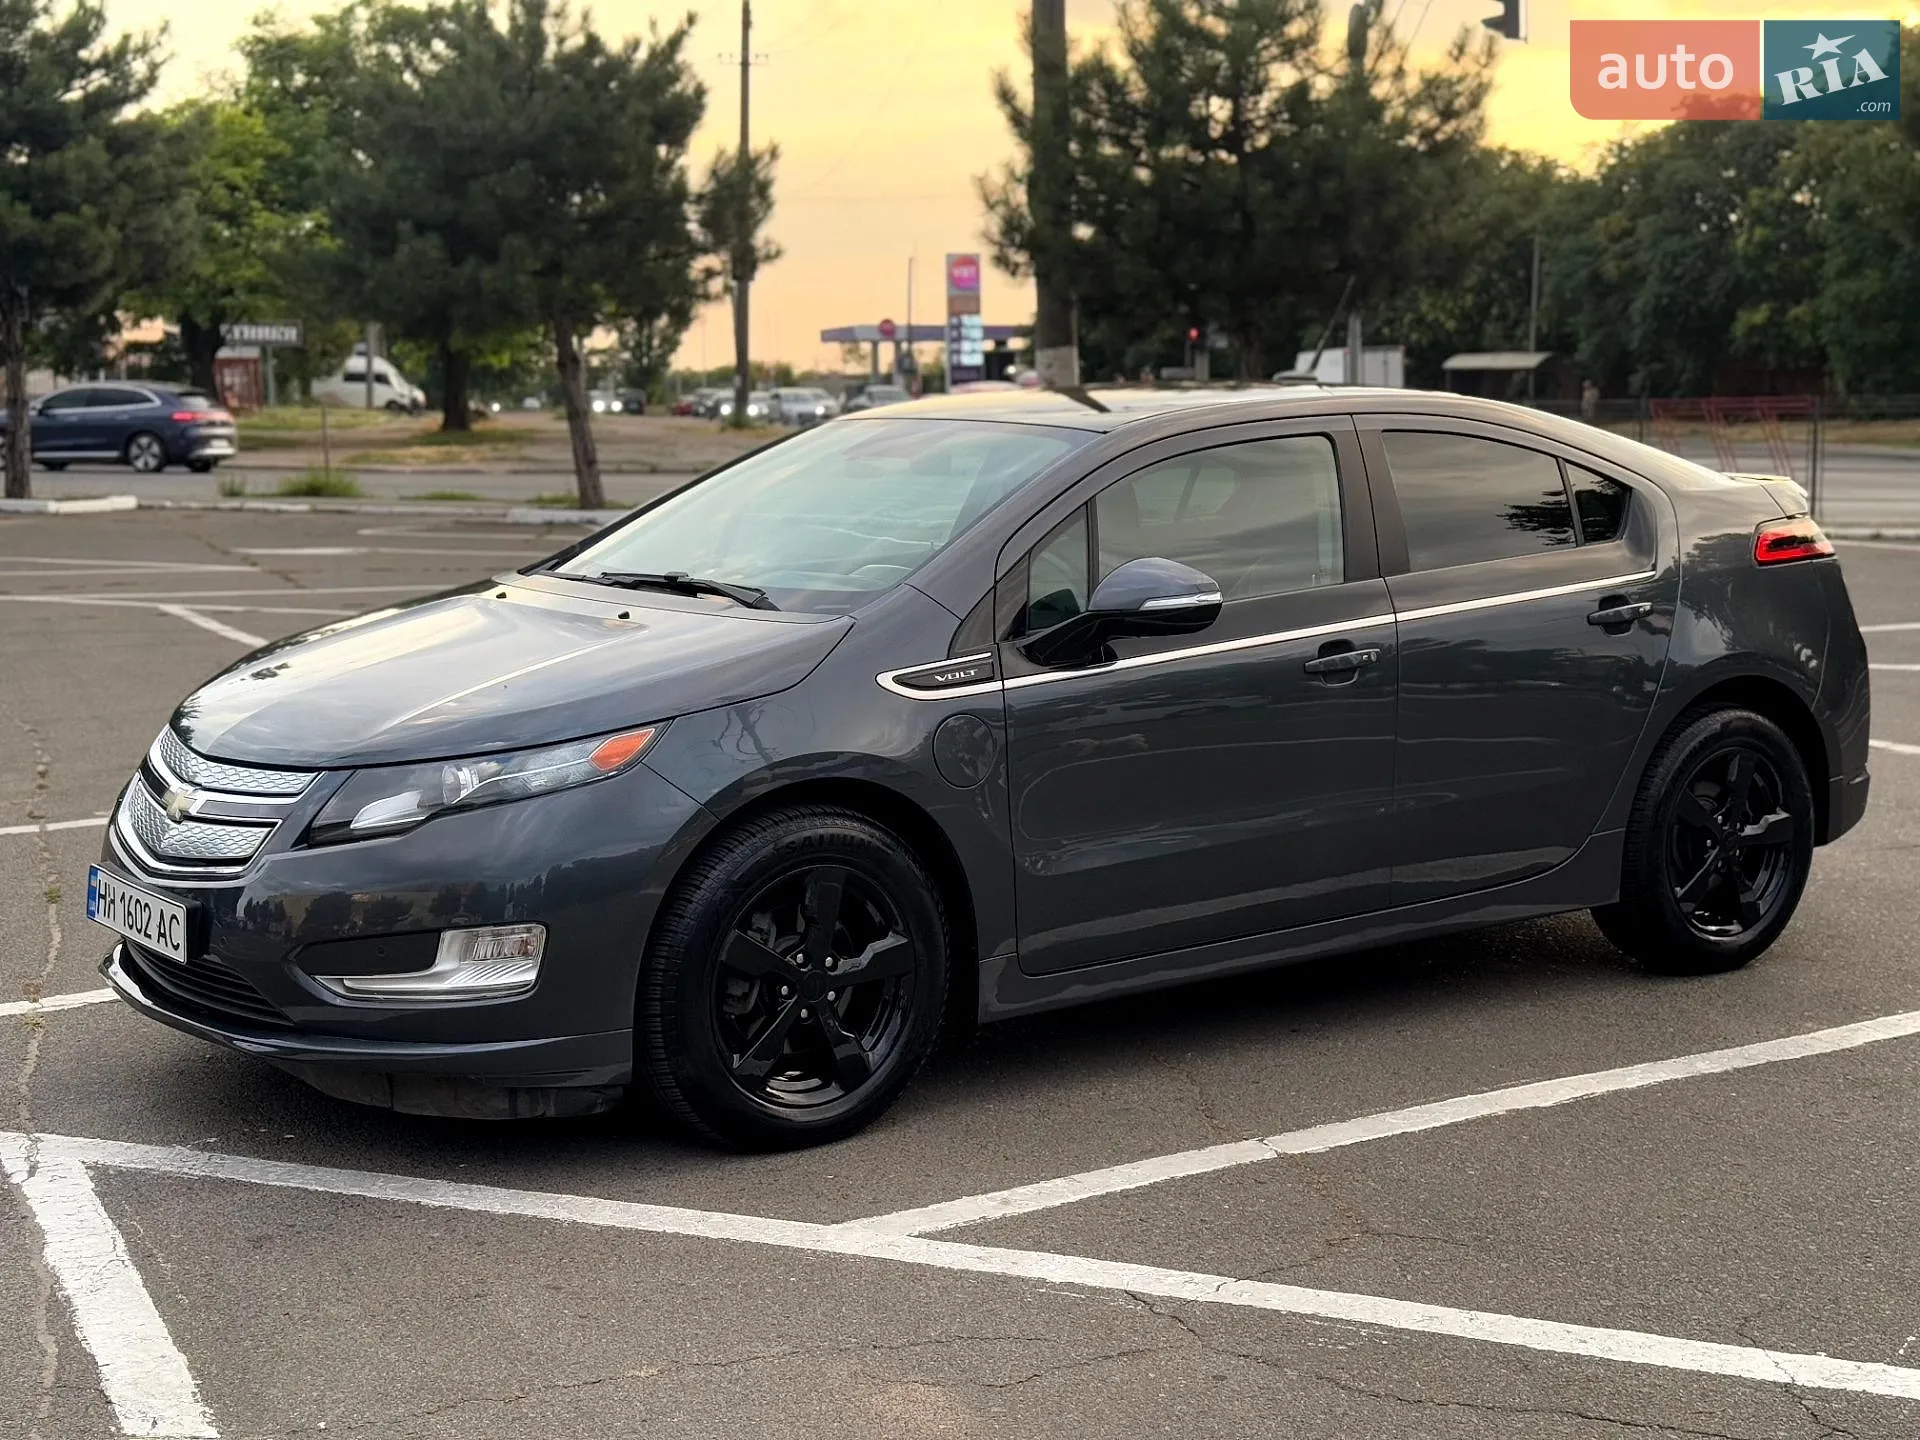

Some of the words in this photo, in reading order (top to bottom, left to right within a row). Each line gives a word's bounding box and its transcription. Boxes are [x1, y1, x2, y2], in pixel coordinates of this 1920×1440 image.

[934, 668, 978, 682] VOLT
[96, 879, 116, 922] HH
[120, 891, 152, 940] 1602
[157, 908, 181, 952] AC
